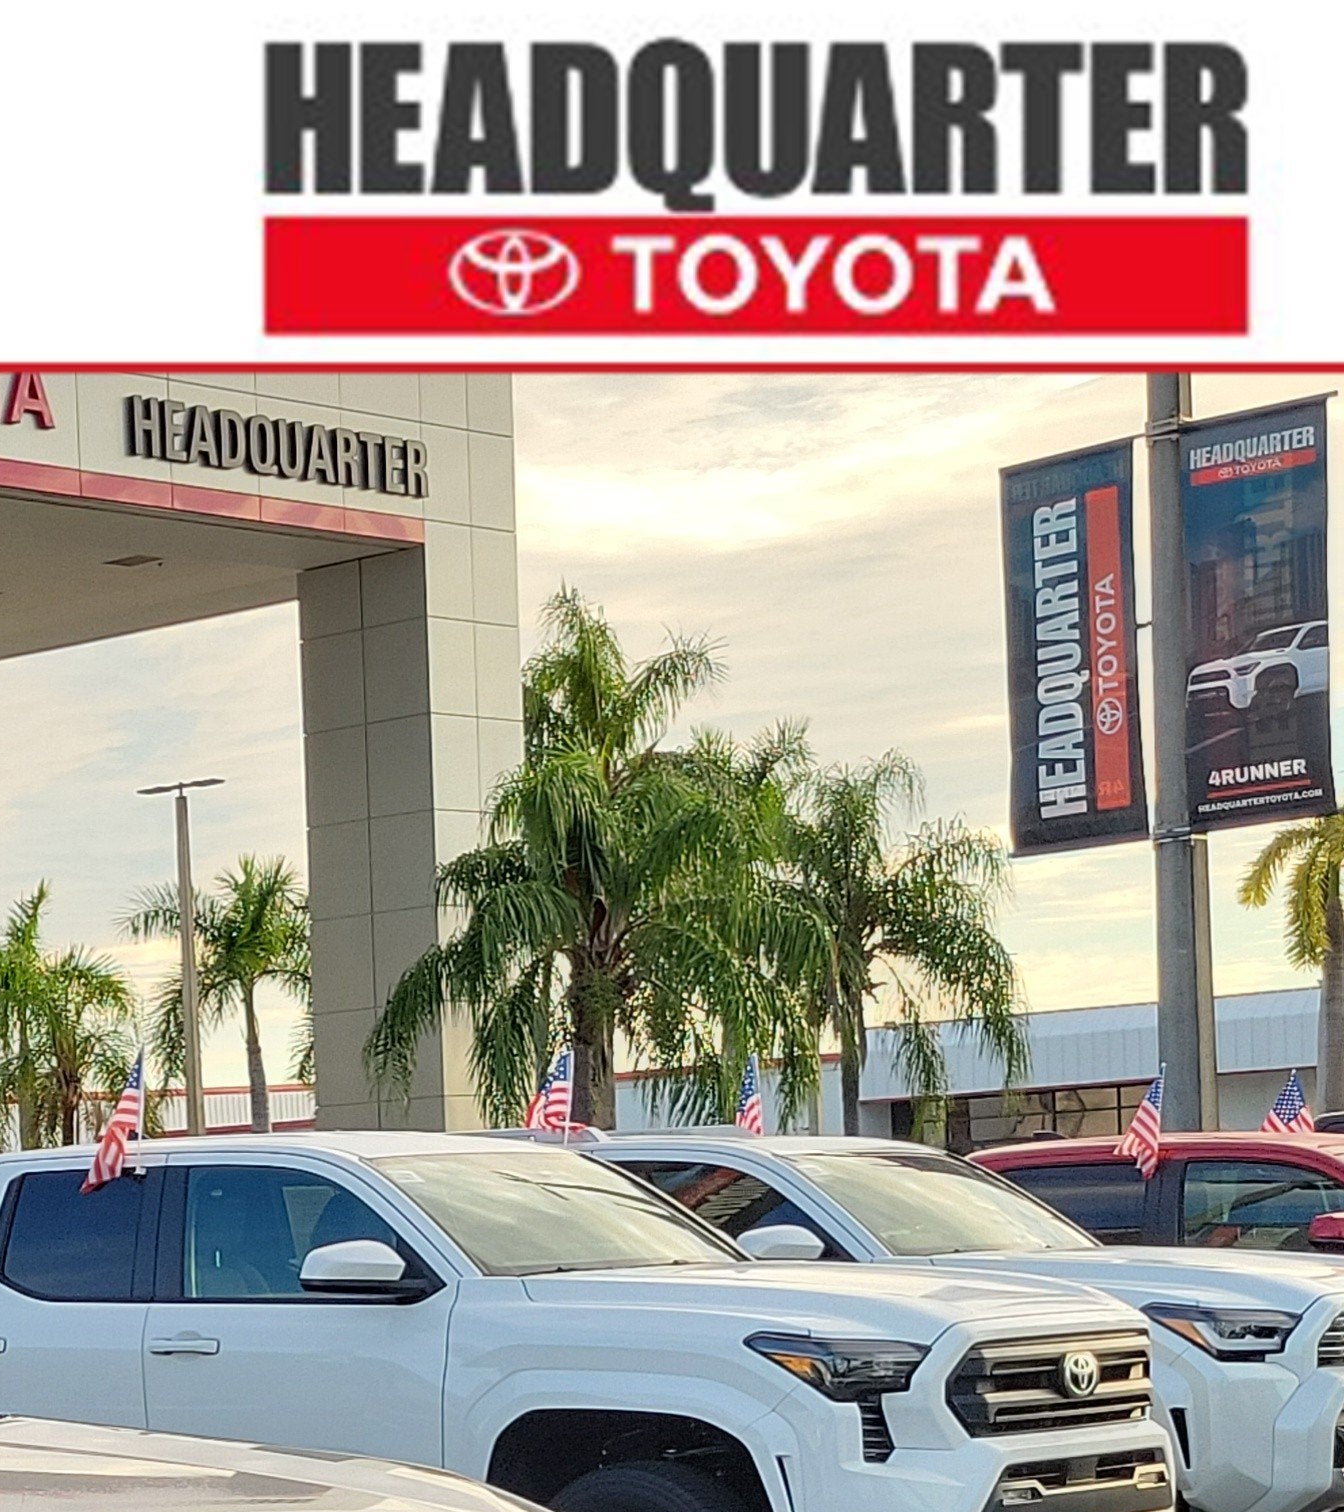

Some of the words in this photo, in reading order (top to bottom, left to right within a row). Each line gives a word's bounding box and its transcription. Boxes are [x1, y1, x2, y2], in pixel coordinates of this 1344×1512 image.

[124, 394, 429, 498] HEADQUARTER
[1189, 426, 1315, 470] HEADQUARTER
[1235, 458, 1282, 475] TOYOTA
[1094, 573, 1120, 695] TOYOTA
[1032, 497, 1091, 819] HEADQUARTER
[1208, 758, 1307, 787] 4RUNNER
[1198, 788, 1323, 814] HEADQUARTERTOYOTA.COM
